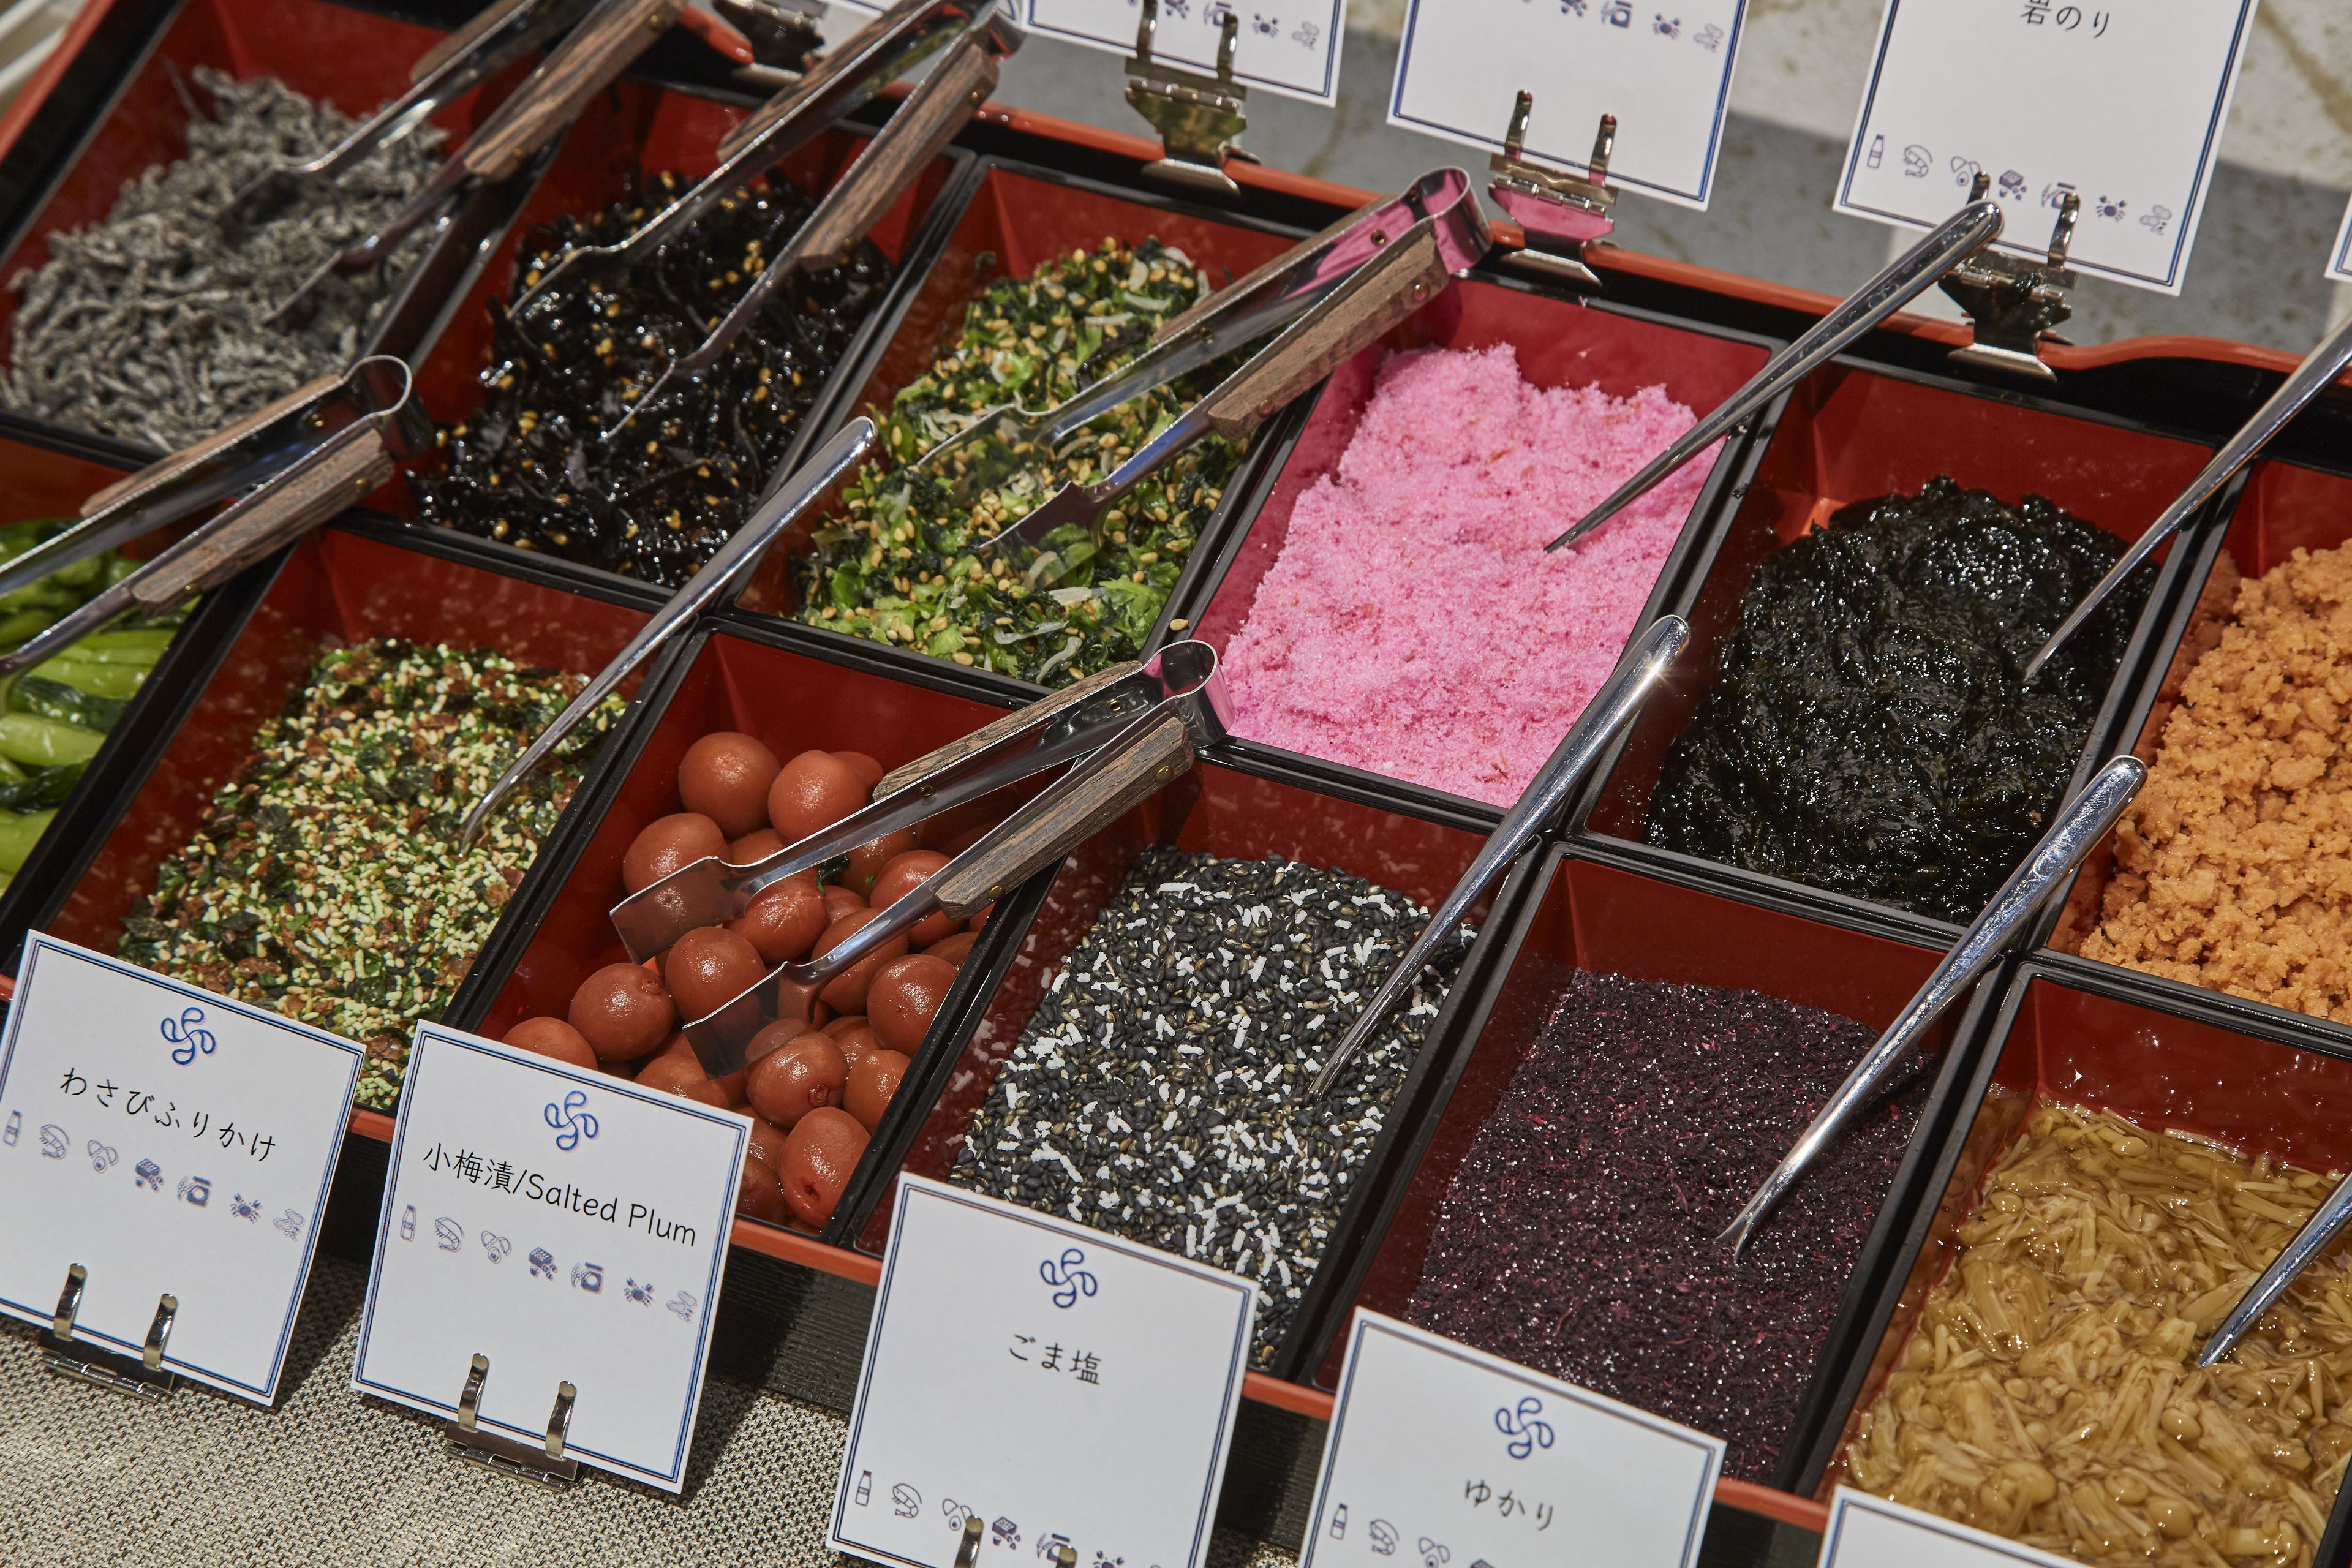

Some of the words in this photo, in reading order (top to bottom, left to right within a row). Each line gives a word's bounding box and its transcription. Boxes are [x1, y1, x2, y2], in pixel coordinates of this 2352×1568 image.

[59, 1066, 276, 1163] わさびふりかけ
[423, 1142, 619, 1224] 小梅漬/Salted
[628, 1203, 696, 1247] Plum
[1009, 1334, 1101, 1385] ごま塩
[1464, 1479, 1554, 1531] ゆかり
